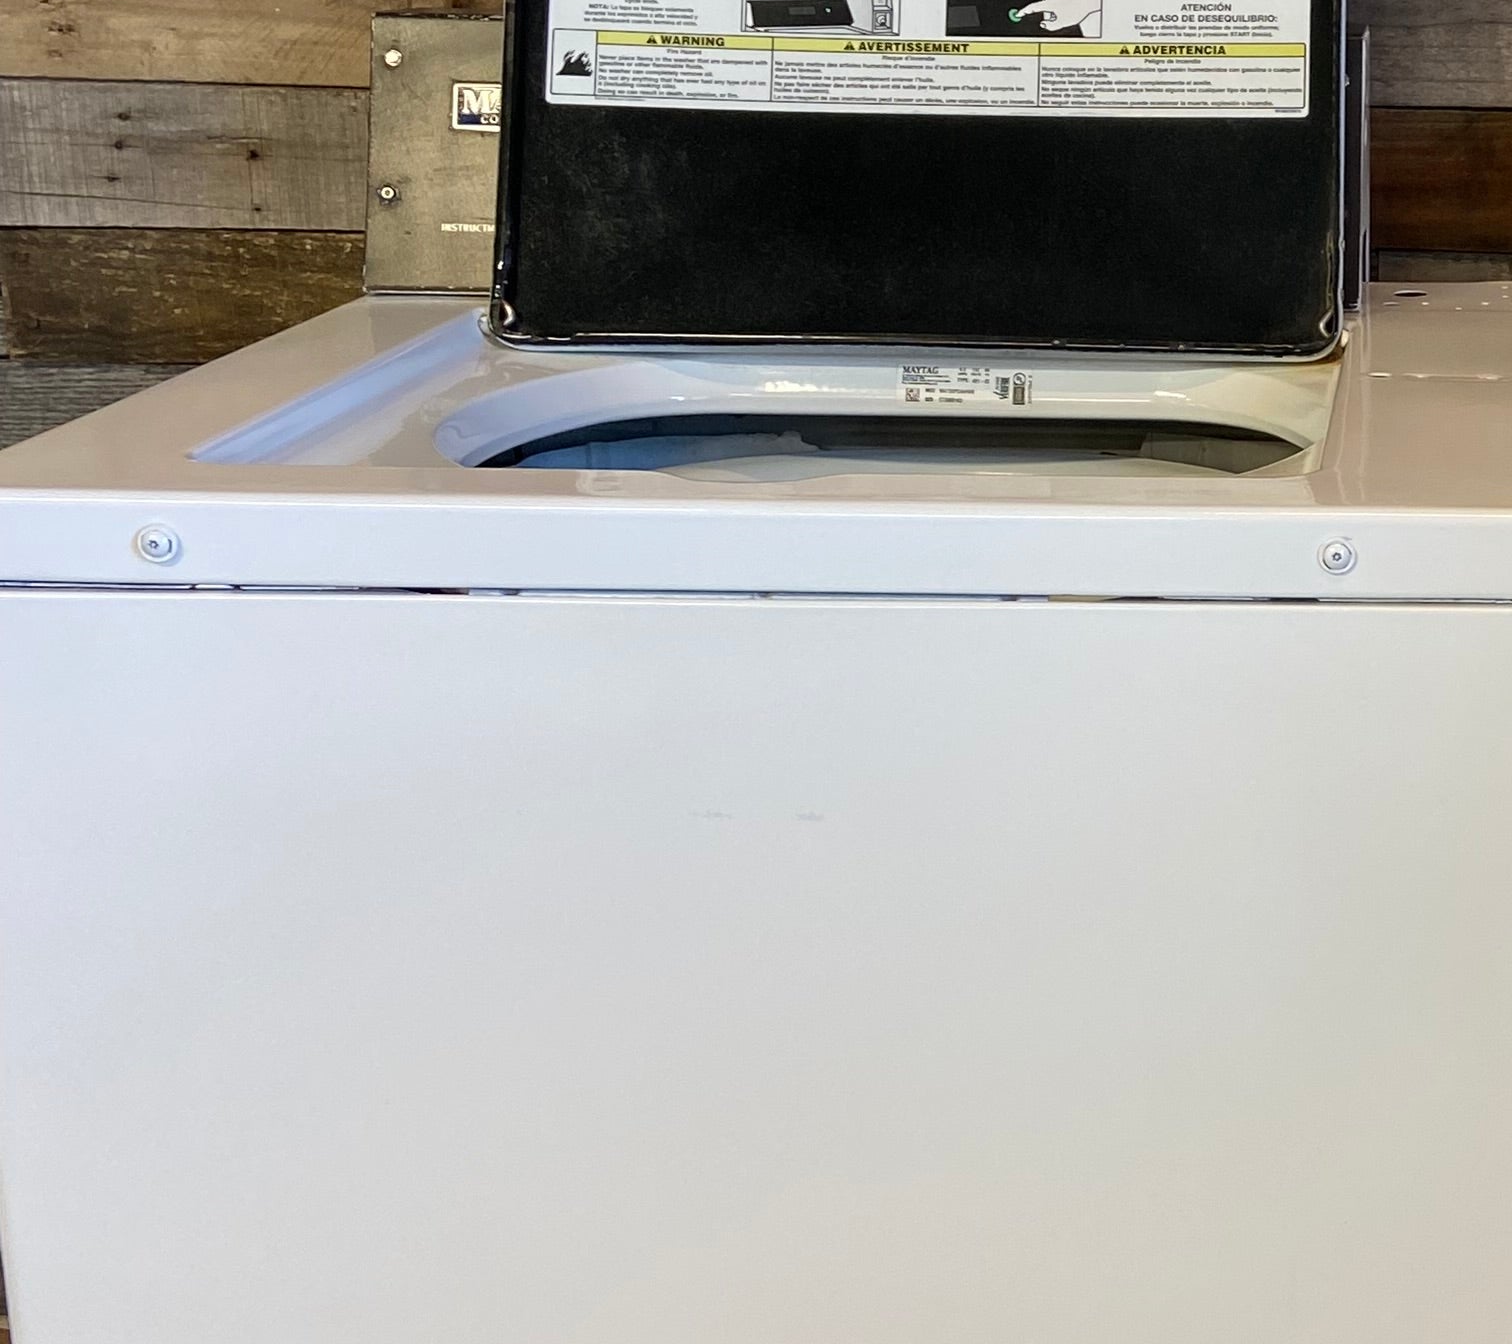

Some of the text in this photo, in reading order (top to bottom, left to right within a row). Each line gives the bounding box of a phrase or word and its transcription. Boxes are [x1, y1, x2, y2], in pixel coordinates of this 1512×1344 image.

[1180, 3, 1232, 12] ATENCIÓN
[1134, 14, 1278, 24] EN CASO DE DESEQUILIBRIO:
[660, 35, 725, 47] WARNING
[858, 41, 970, 53] AVERTISSEMENT
[1132, 45, 1227, 55] ADVERTENCIA
[903, 366, 939, 374] MAYTAG
